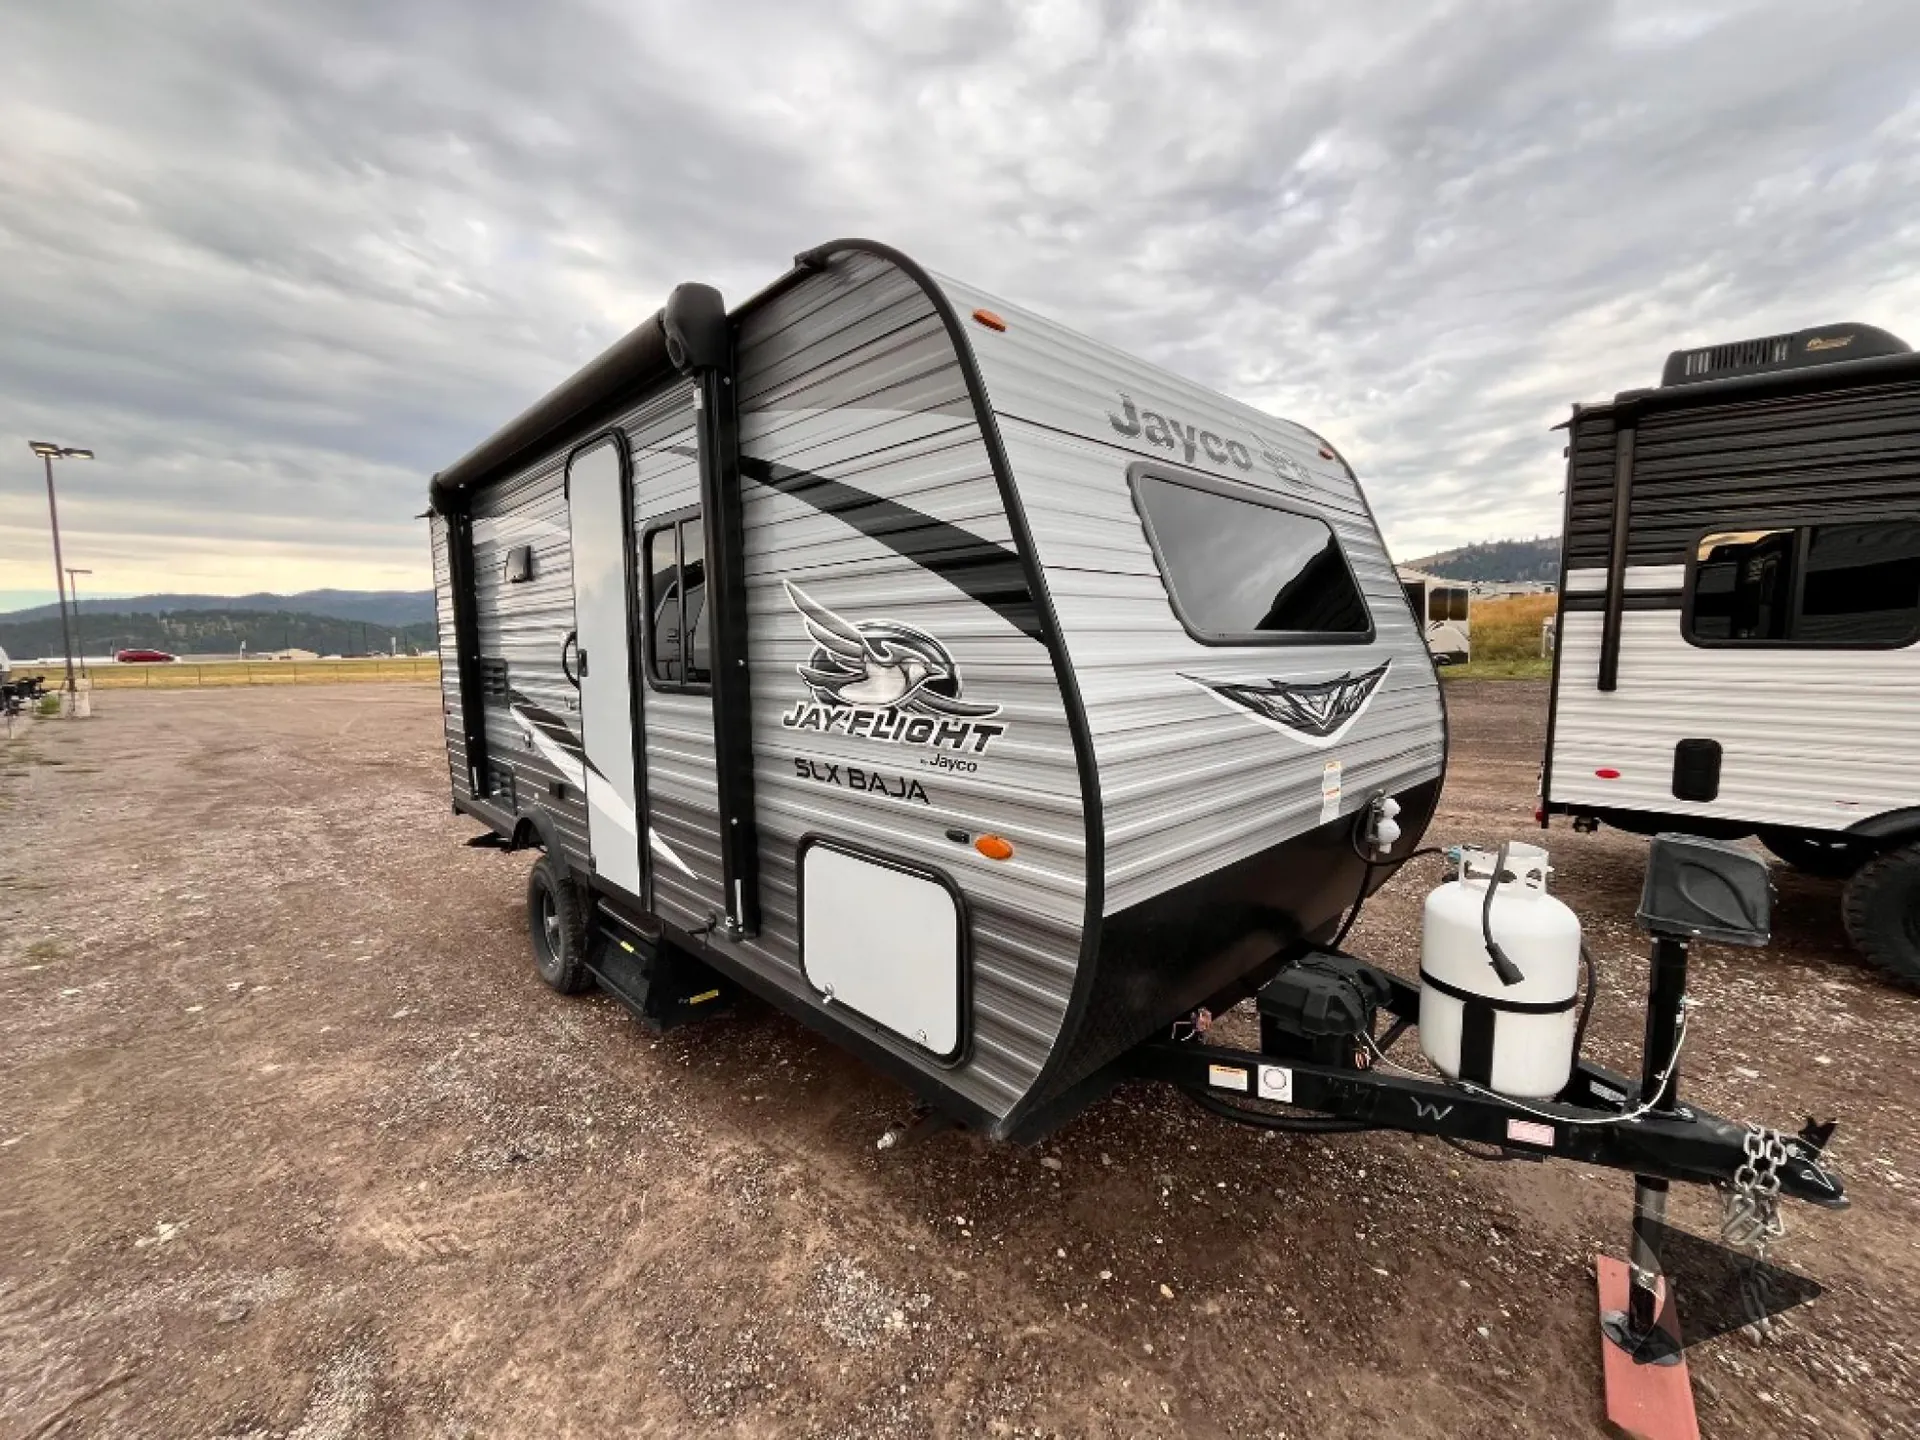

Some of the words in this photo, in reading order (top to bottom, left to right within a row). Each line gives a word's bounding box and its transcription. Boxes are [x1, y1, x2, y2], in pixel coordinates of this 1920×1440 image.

[1106, 390, 1253, 471] Jayco
[794, 757, 841, 785] SLX
[848, 767, 930, 805] BAJA
[929, 753, 978, 773] Jayco
